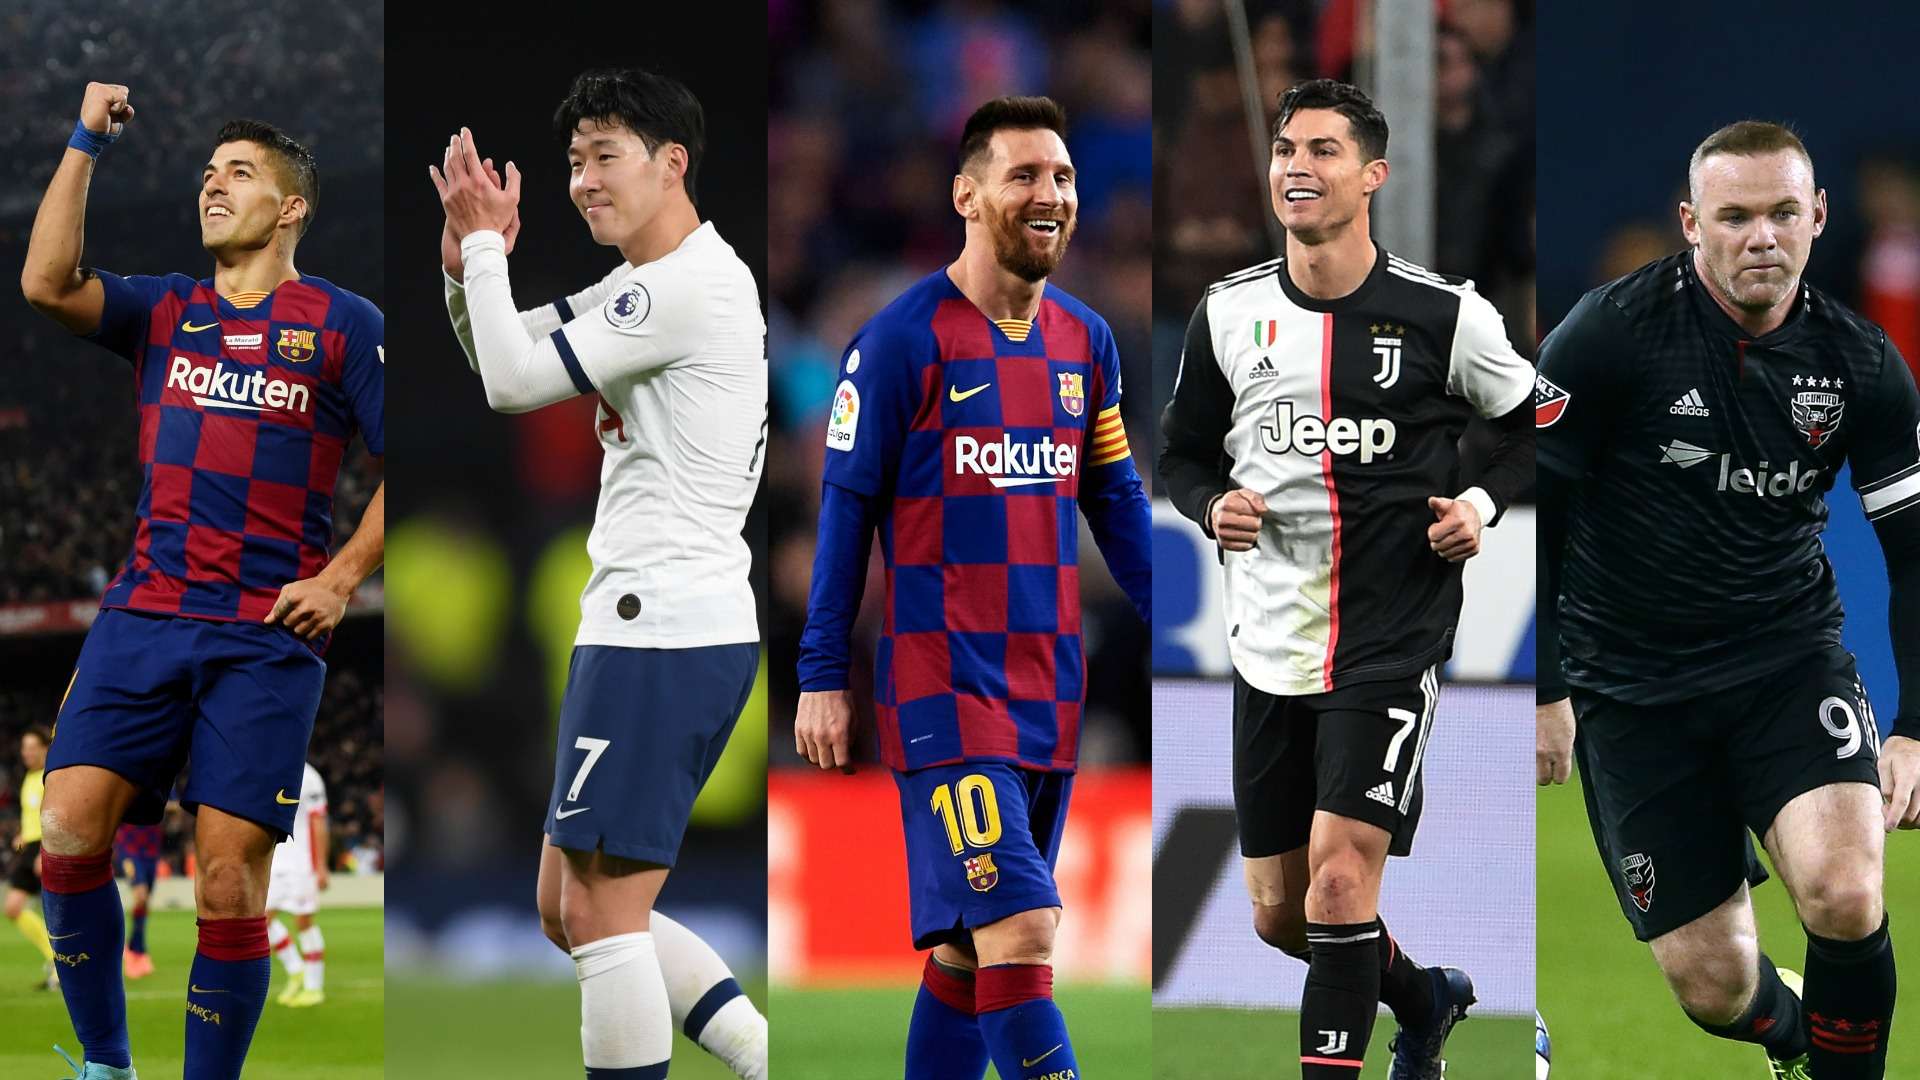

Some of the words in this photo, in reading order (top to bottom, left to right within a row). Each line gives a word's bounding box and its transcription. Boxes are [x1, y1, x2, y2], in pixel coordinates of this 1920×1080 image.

[167, 356, 309, 412] Rakuten
[1249, 370, 1279, 379] adidas
[1811, 394, 1838, 406] UNITED
[1260, 402, 1396, 464] Jeep
[1670, 405, 1710, 417] adidas
[1717, 453, 1829, 497] leido
[1383, 708, 1417, 773] 7
[1819, 696, 1863, 759] 9
[567, 736, 611, 801] 7
[930, 774, 1003, 856] 10
[1365, 790, 1395, 807] adidas
